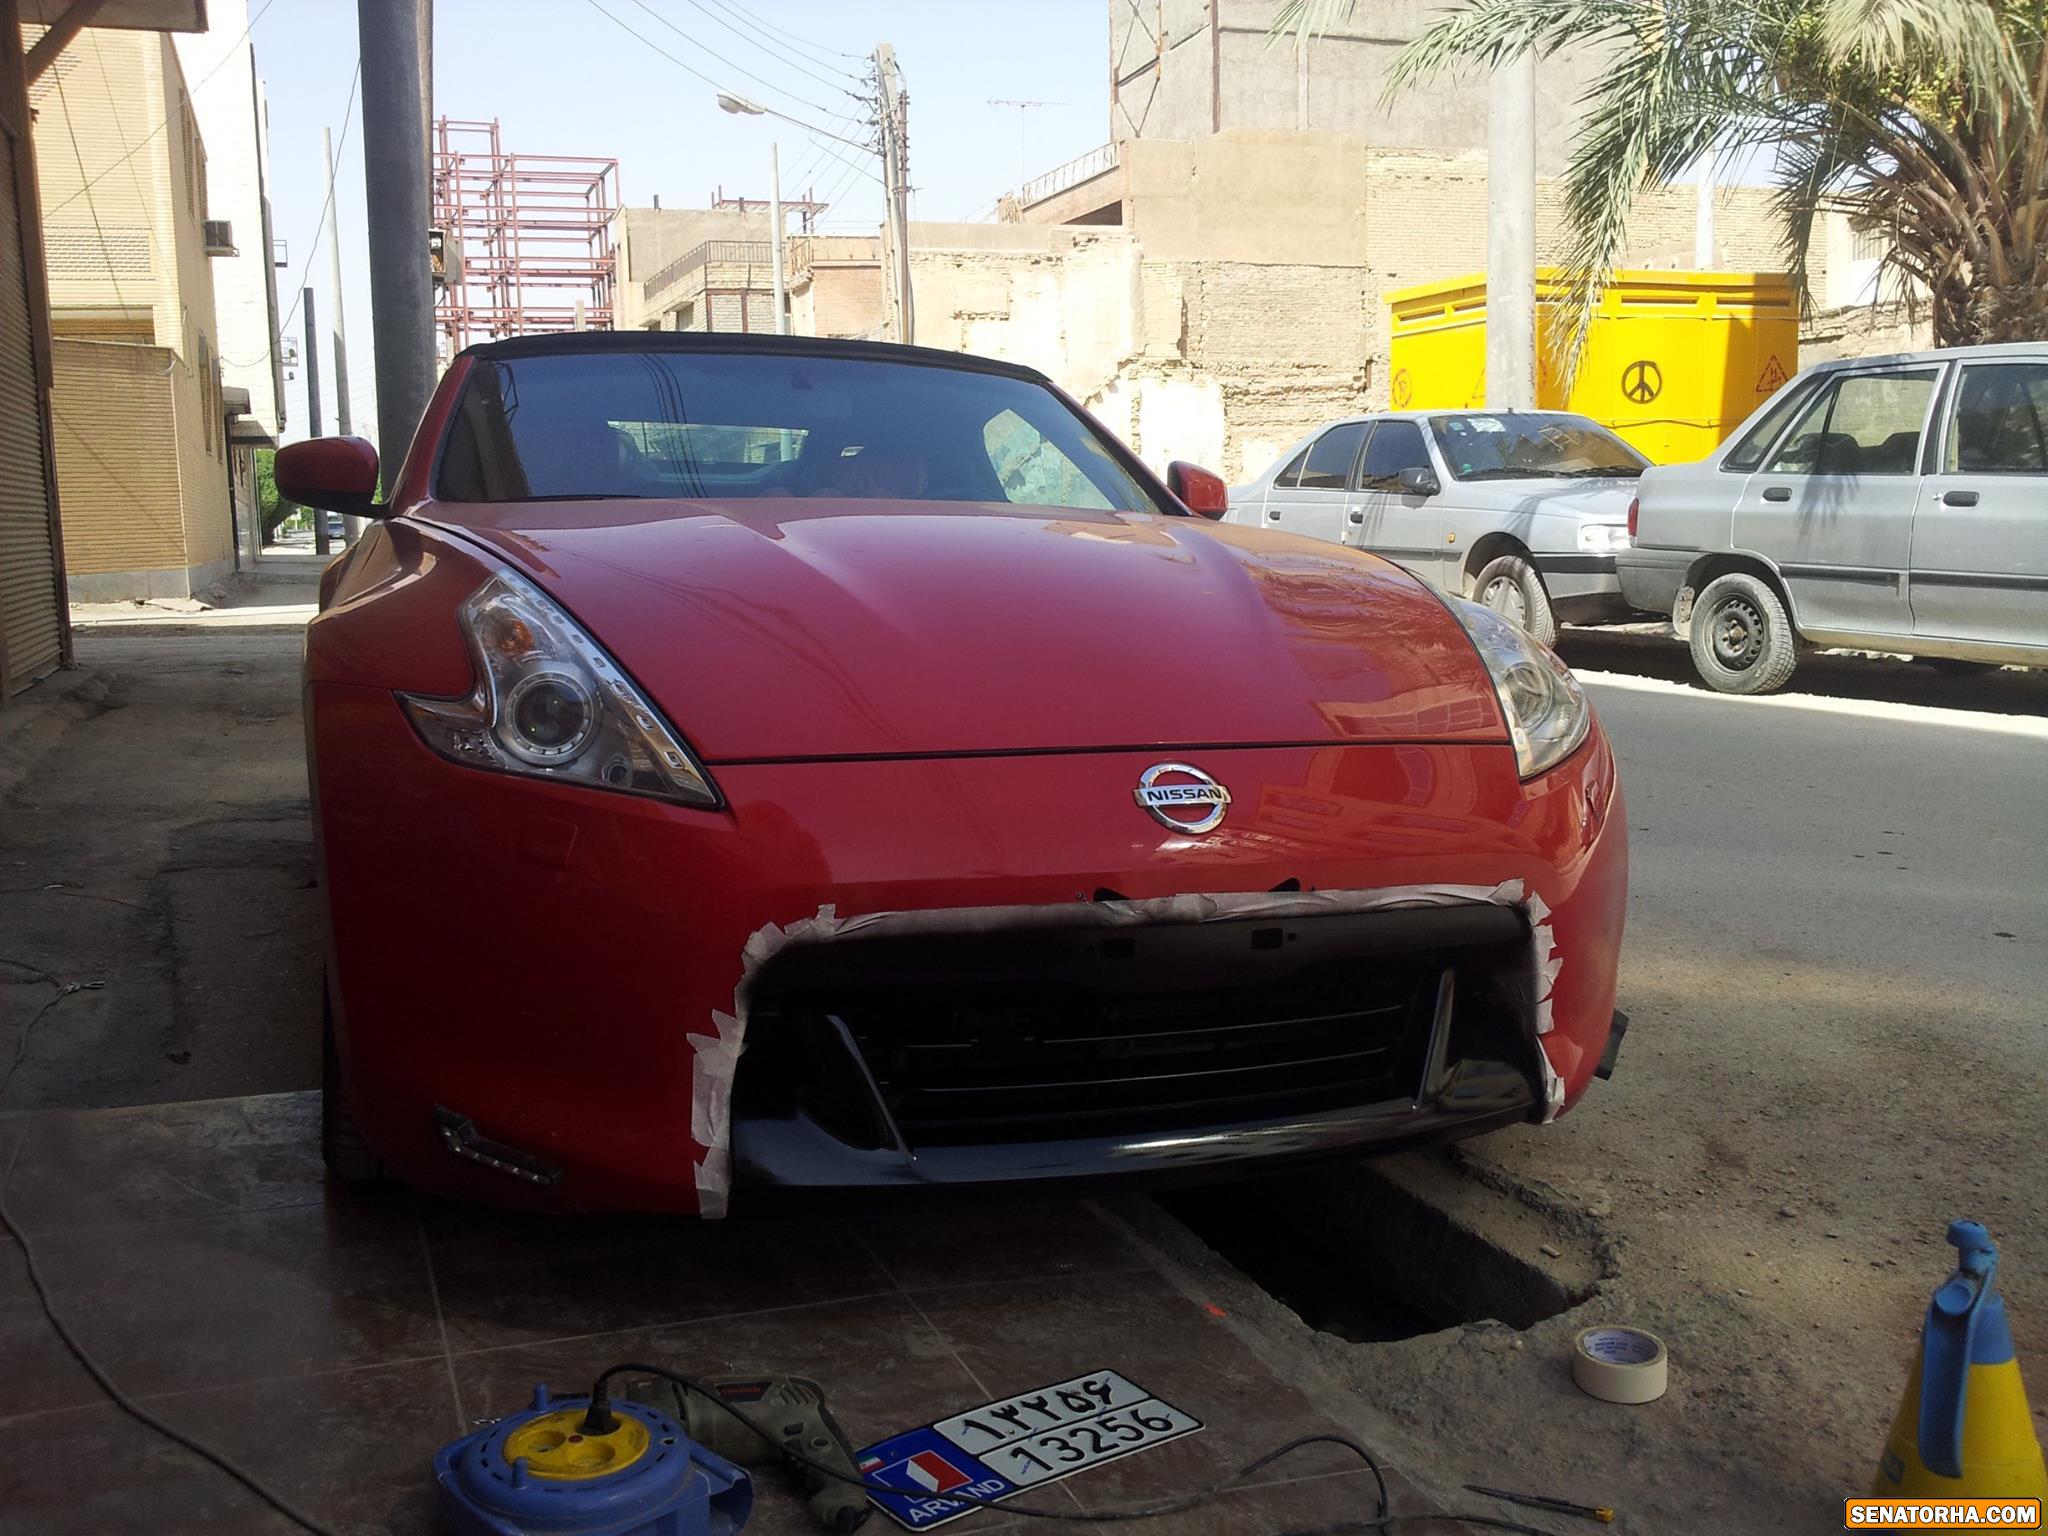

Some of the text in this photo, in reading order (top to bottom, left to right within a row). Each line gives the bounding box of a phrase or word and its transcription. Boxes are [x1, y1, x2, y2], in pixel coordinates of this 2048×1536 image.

[1146, 788, 1222, 802] NISSAN
[964, 1380, 1113, 1440] ۱۳۲۵۶
[1010, 1408, 1174, 1472] 13256
